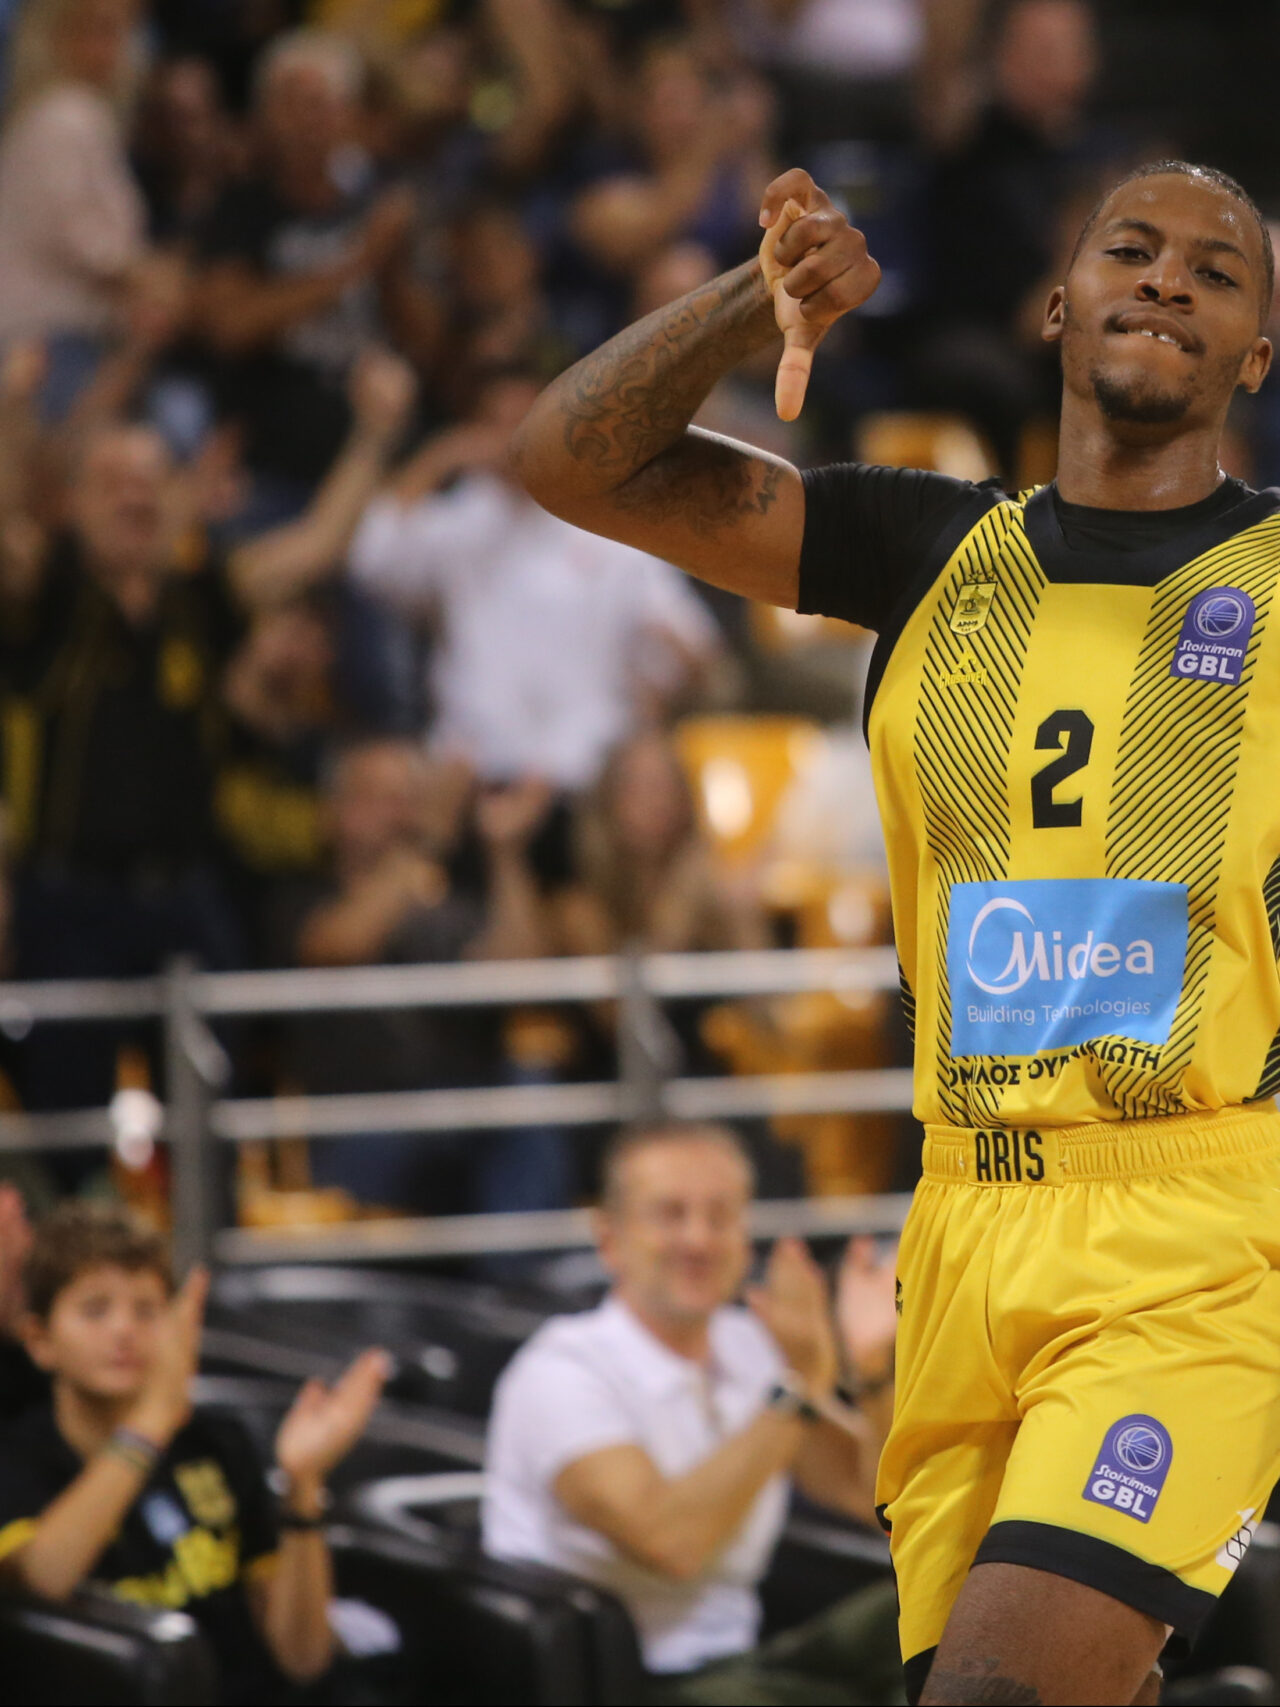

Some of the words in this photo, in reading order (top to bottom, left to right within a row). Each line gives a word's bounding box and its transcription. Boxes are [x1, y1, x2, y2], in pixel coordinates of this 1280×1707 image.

[1177, 653, 1235, 680] GBL
[1178, 639, 1243, 658] Stoiximan
[1030, 708, 1095, 829] 2
[966, 897, 1154, 994] Midea
[967, 1005, 1035, 1026] Building
[1041, 997, 1152, 1024] Tehnologies
[975, 1130, 1045, 1182] ARIS
[1092, 1479, 1146, 1518] GBL
[1095, 1464, 1158, 1498] Stoiximan
